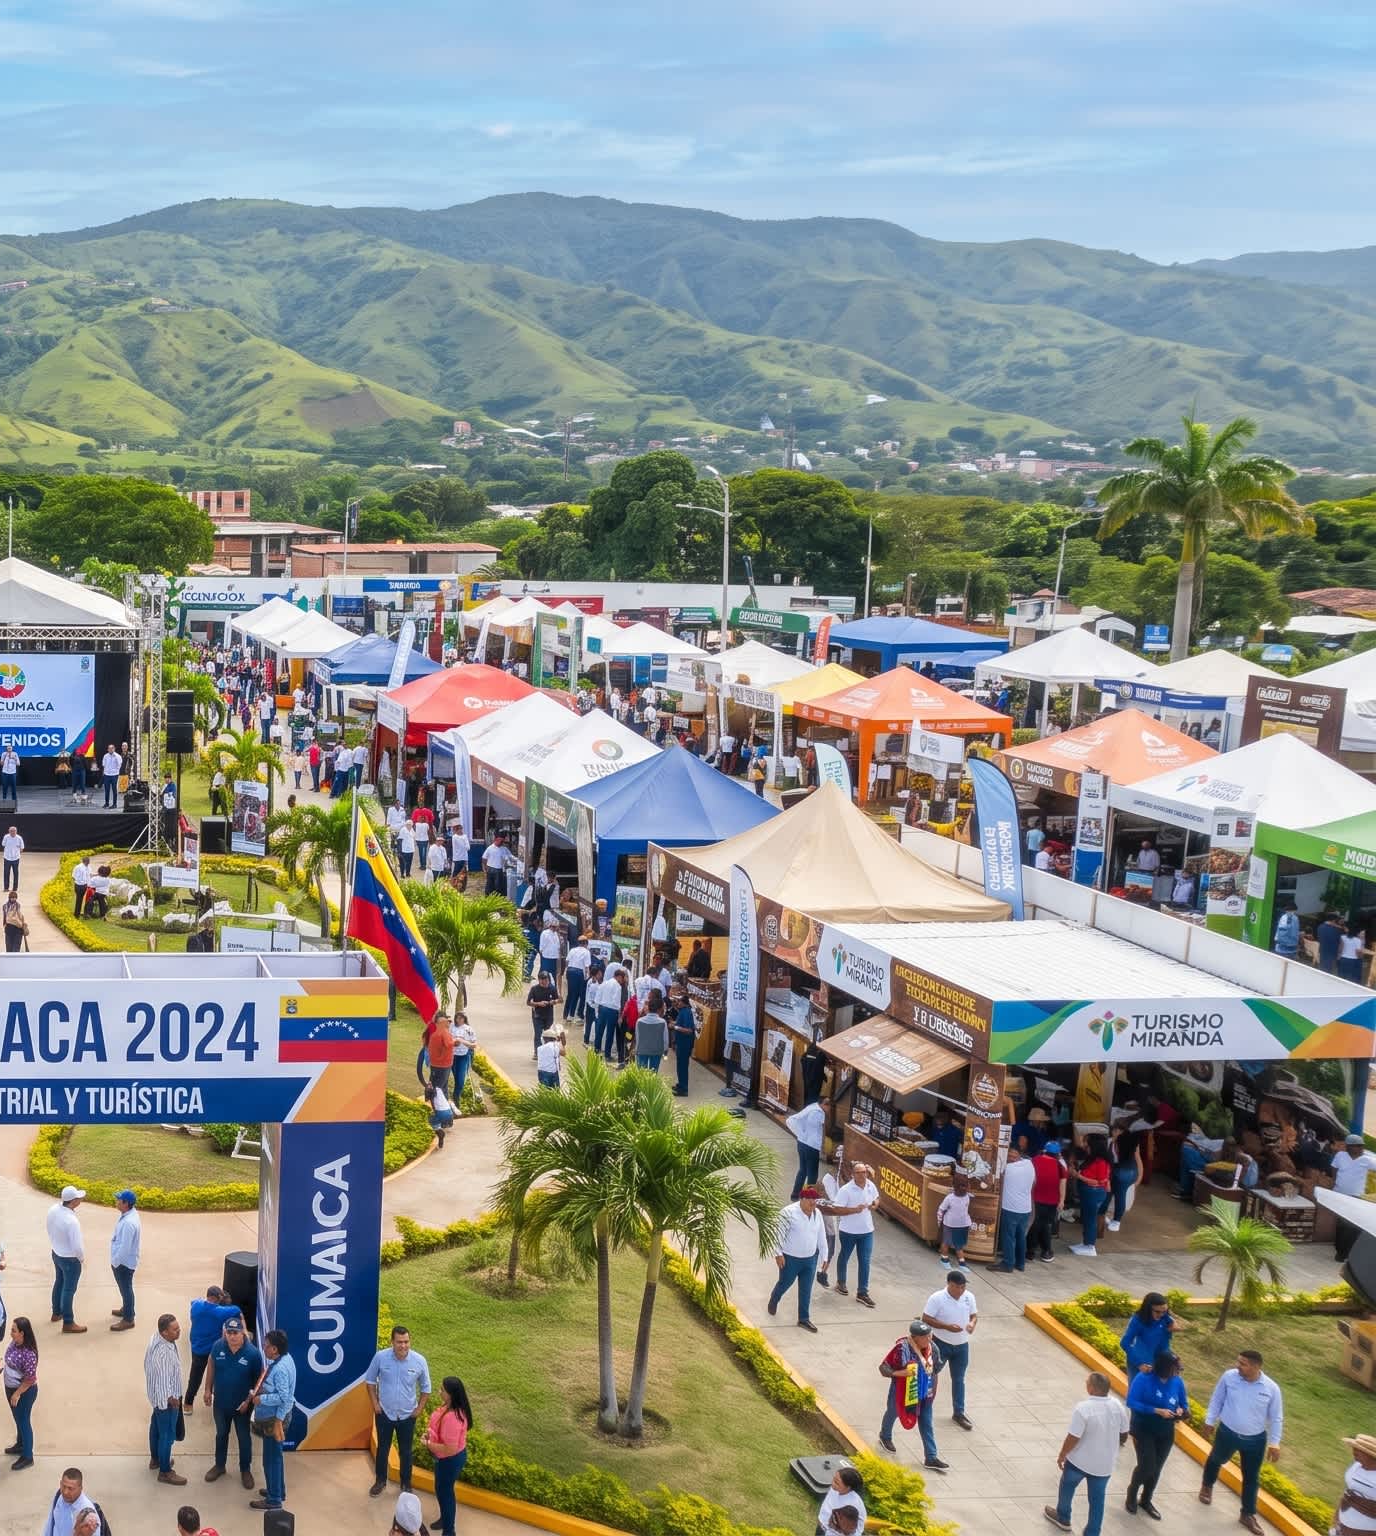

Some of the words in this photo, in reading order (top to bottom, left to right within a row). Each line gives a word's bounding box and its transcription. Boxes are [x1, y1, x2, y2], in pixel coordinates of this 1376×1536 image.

[127, 1001, 259, 1062] 2024
[1131, 1013, 1224, 1030] TURISMO
[65, 1087, 80, 1115] Y
[86, 1082, 204, 1115] TURÍSTICA
[307, 1153, 352, 1375] CUMAICA
